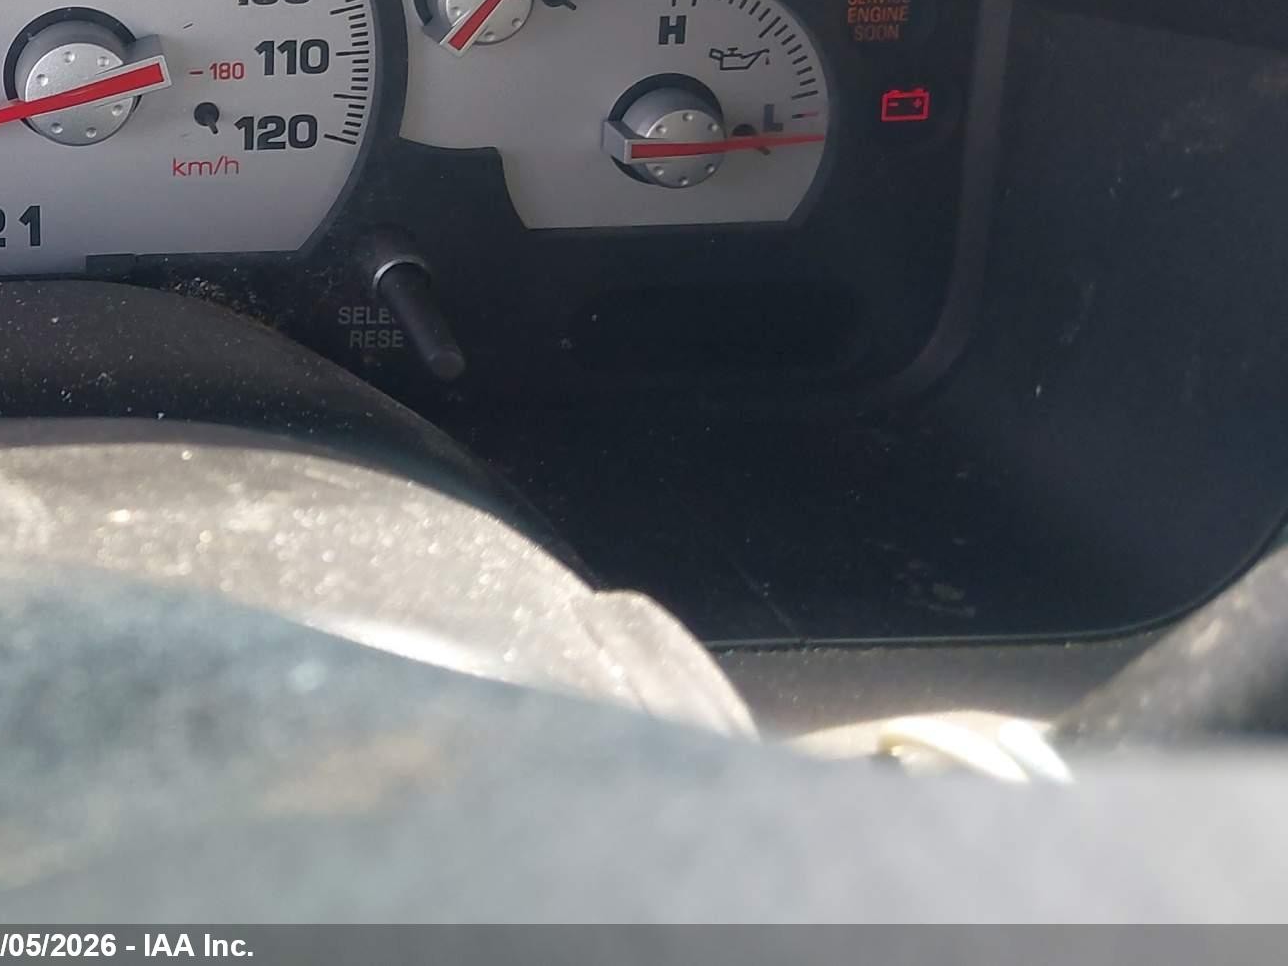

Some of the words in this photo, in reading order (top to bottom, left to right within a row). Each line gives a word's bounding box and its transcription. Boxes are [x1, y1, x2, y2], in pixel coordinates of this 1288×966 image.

[848, 7, 910, 23] ENGINE
[658, 14, 687, 46] H
[854, 25, 899, 42] SOON
[254, 38, 330, 76] 110
[209, 62, 245, 80] 180
[764, 104, 784, 132] L
[233, 114, 318, 151] 120
[172, 155, 239, 177] km/h
[337, 307, 396, 324] SELE
[349, 330, 404, 348] RESE
